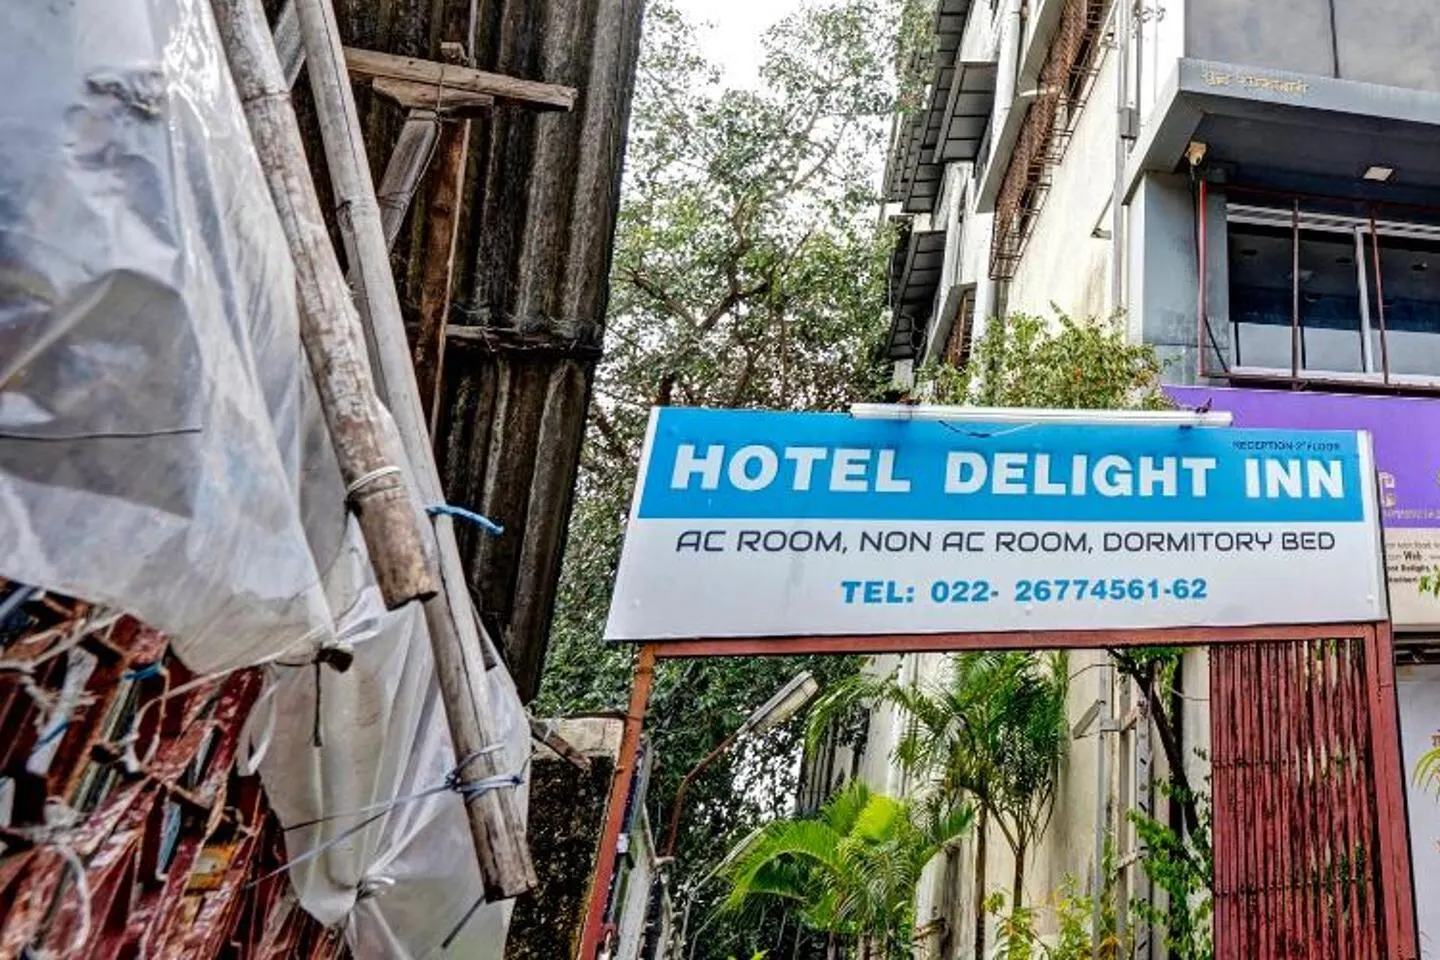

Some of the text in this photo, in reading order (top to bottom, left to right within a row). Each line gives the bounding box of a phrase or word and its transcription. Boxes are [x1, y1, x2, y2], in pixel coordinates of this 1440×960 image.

[670, 444, 912, 492] HOTEL
[944, 451, 1217, 498] DELIGHT
[1245, 458, 1345, 499] INN
[675, 530, 1336, 555] AC ROOM, NON AC ROOM, DORMITORY BED
[840, 577, 1209, 604] TEL: 022- 26774561-62
